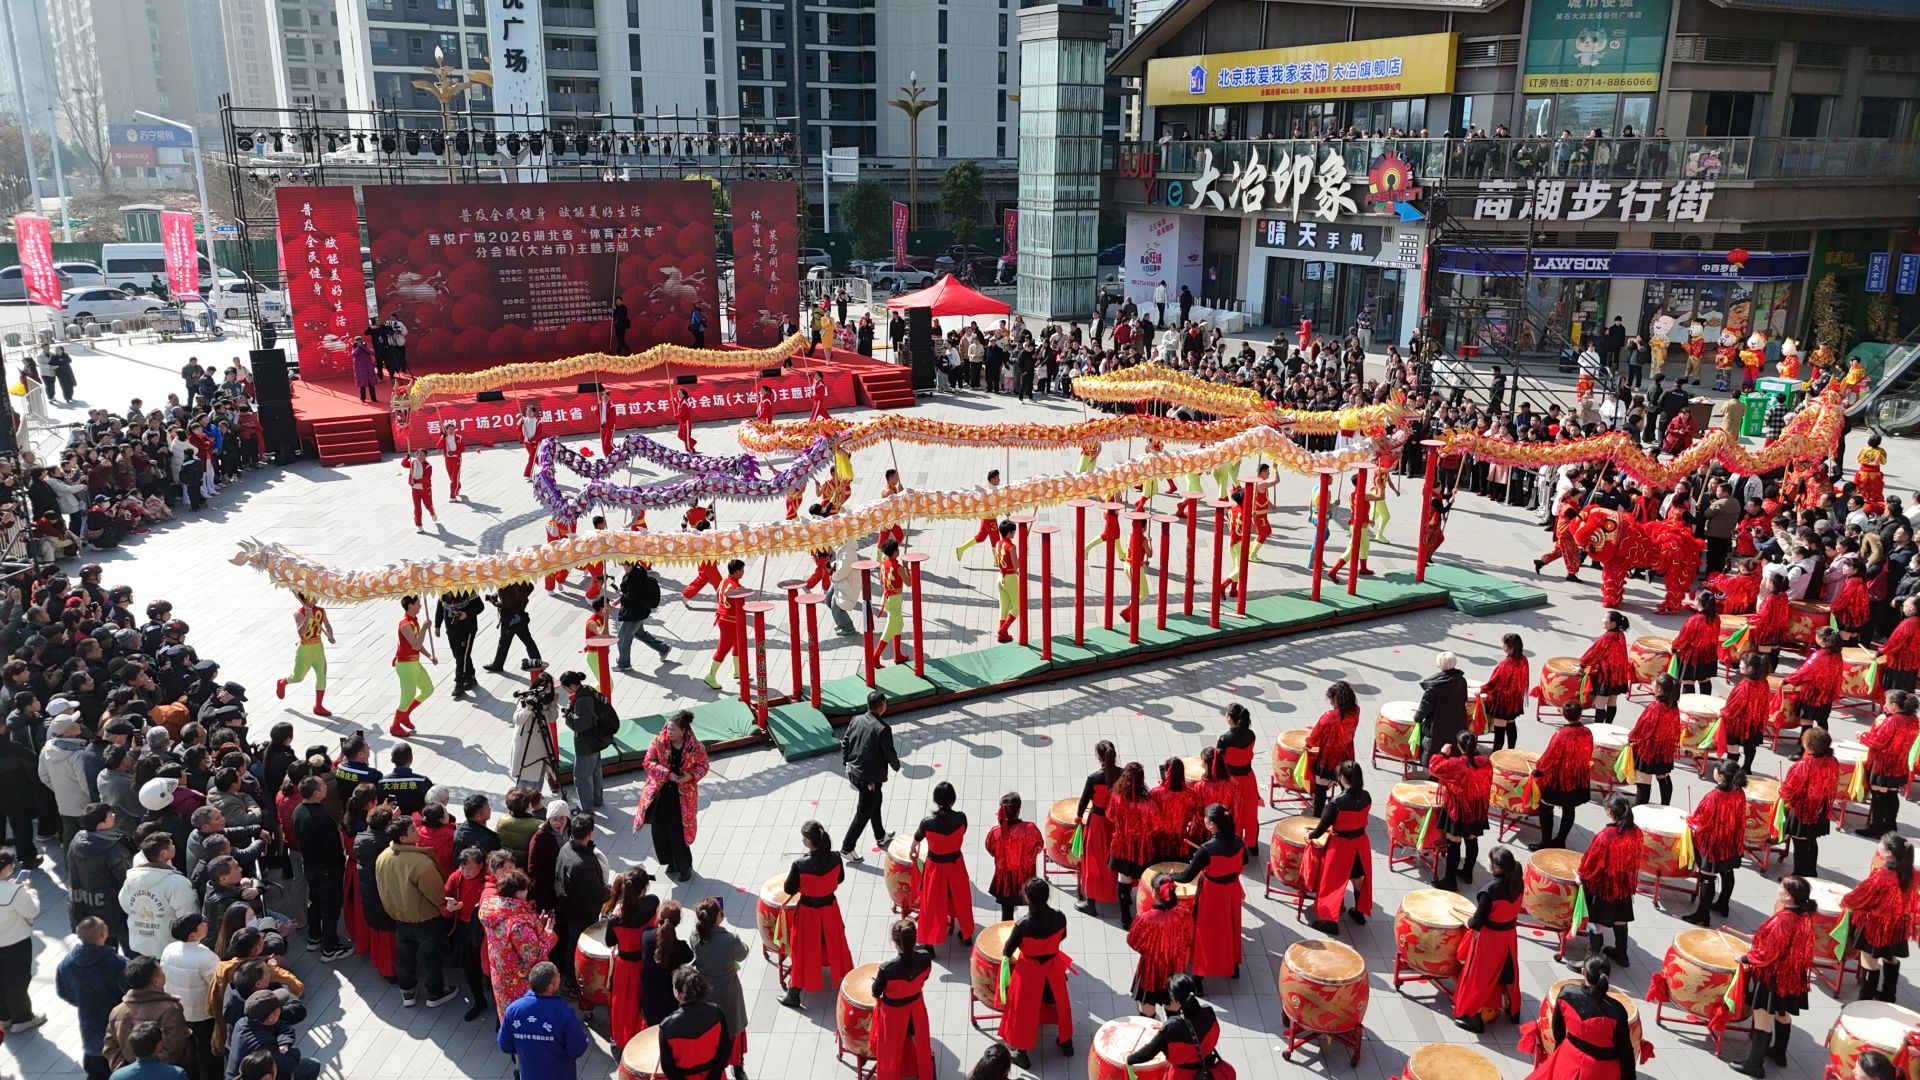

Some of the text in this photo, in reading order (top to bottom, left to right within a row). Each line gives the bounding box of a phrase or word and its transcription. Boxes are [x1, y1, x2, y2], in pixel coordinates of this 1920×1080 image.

[1217, 57, 1402, 88] 北京我爱我家装饰 大冶旗舰店
[1188, 146, 1358, 223] 大冶印象
[1473, 179, 1716, 222] 高潮步行街
[458, 205, 642, 222] 普及全民健身 赋能美好生活
[301, 202, 323, 296] 普及全民健身
[750, 210, 764, 275] 体育过大年
[1267, 220, 1364, 251] 晴天手机
[768, 229, 780, 295] 策马同春行
[1533, 257, 1611, 270] LAWSON
[1869, 256, 1882, 289] 好久不见
[324, 236, 347, 327] 赋能美好生活
[335, 769, 358, 782] 大冶应急
[383, 782, 417, 790] 大冶应急
